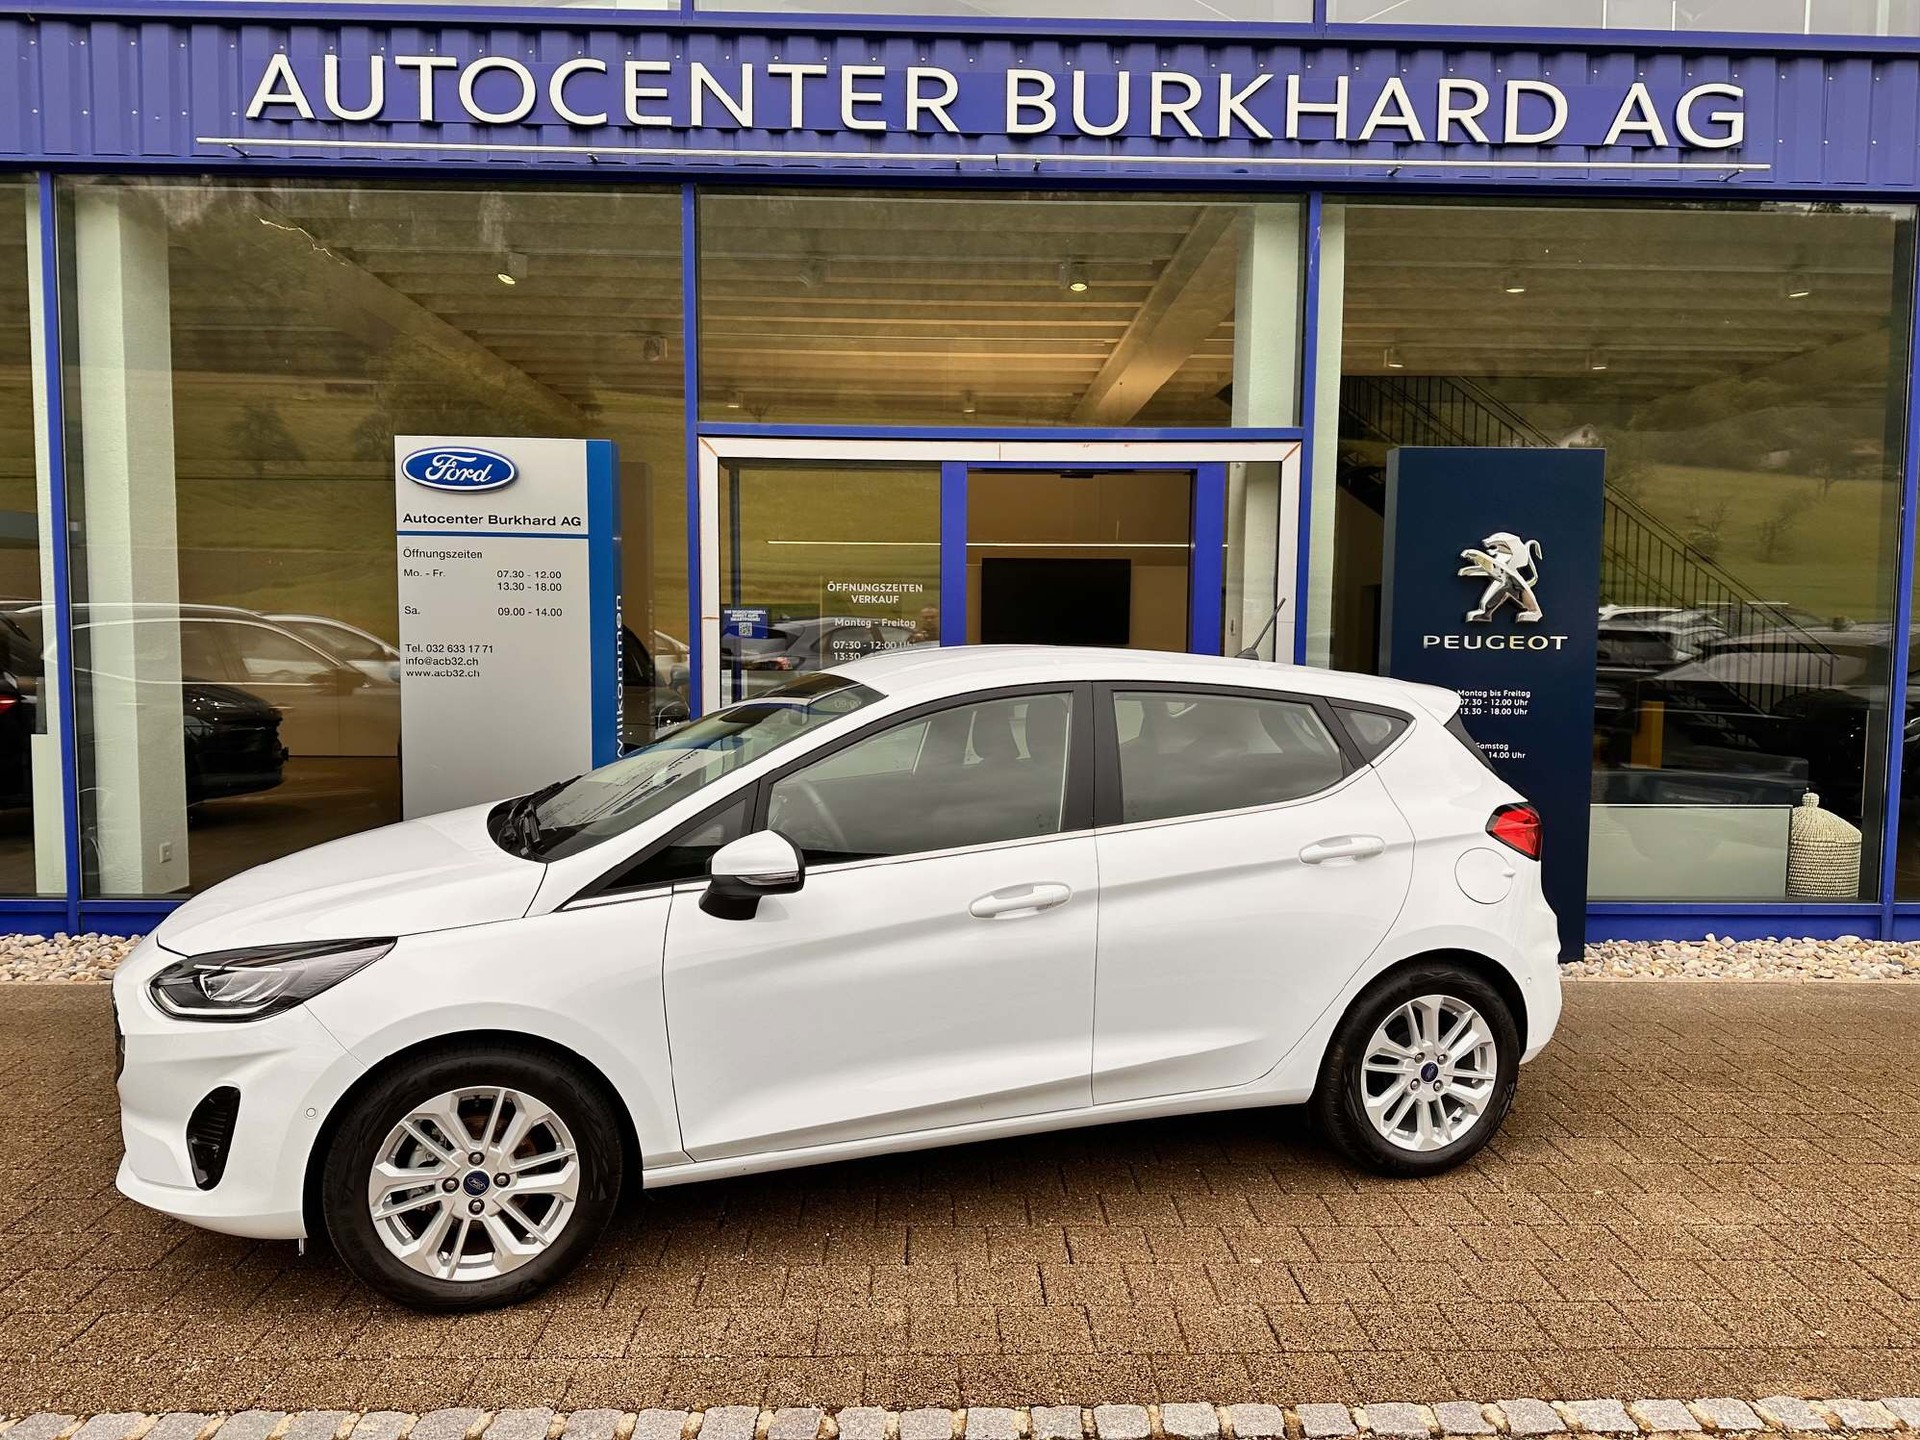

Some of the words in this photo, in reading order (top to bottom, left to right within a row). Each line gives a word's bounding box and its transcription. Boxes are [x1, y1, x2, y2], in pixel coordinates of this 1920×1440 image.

[246, 53, 961, 133] AUTOCENTER
[1006, 68, 1568, 144] BURKHARD
[1603, 81, 1746, 149] AG
[424, 453, 493, 482] Ford
[402, 513, 484, 525] Autocenter
[488, 514, 556, 526] Burkhard
[560, 516, 582, 527] AG
[402, 547, 483, 561] Öffnungszeiten
[403, 568, 423, 578] Mo.
[432, 568, 446, 578] Fr.
[496, 569, 525, 580] 07.30
[534, 570, 562, 580] 12.00
[497, 581, 525, 592] 13.30
[535, 582, 562, 592] 18.00
[827, 580, 923, 593] ÖFFNUNGSZEITEN
[851, 594, 899, 604] VERKAUF
[404, 605, 421, 615] Sa.
[497, 607, 525, 617] 09.00
[535, 607, 563, 617] 14.00
[834, 619, 872, 629] Montag
[881, 619, 916, 629] Freitag
[833, 641, 861, 650] 07:30
[870, 641, 897, 650] 12:00
[1423, 635, 1569, 650] PEUGEOT
[405, 643, 423, 653] Tel.
[425, 643, 445, 654] 032
[446, 644, 466, 654] 633
[405, 656, 479, 667] info@acb32.ch
[833, 653, 861, 661] 13:30
[405, 669, 480, 678] www.acb32.ch
[1457, 689, 1488, 698] Montag
[1489, 689, 1502, 697] bis
[1503, 689, 1531, 699] Freitag
[1459, 698, 1483, 706] 07.30
[1490, 698, 1512, 706] 12.00
[1513, 698, 1529, 706] Uhr
[1459, 707, 1482, 715] 13.30
[1490, 707, 1512, 715] 18.00
[1513, 707, 1528, 715] Uhr
[1488, 751, 1510, 759] 14.00
[1511, 751, 1526, 759] Uhr
